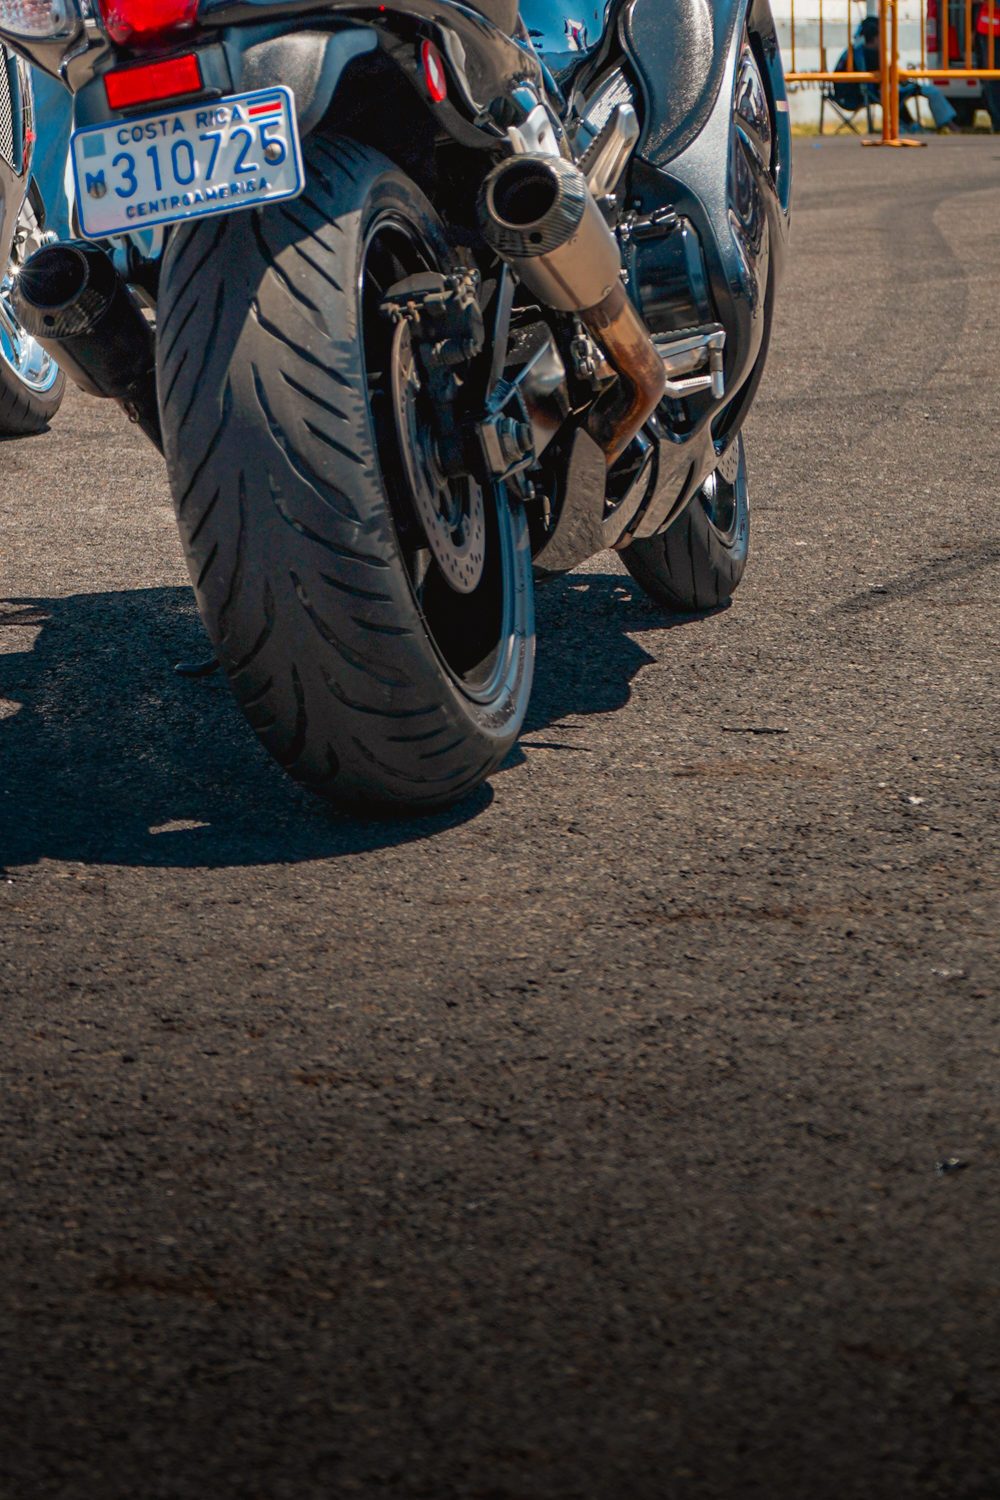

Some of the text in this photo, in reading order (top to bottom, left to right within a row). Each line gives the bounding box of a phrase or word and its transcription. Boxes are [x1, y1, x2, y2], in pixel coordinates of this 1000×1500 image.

[117, 104, 246, 146] COSTA RICA
[112, 119, 288, 199] 310725
[126, 177, 272, 219] CENTROAMERICA
